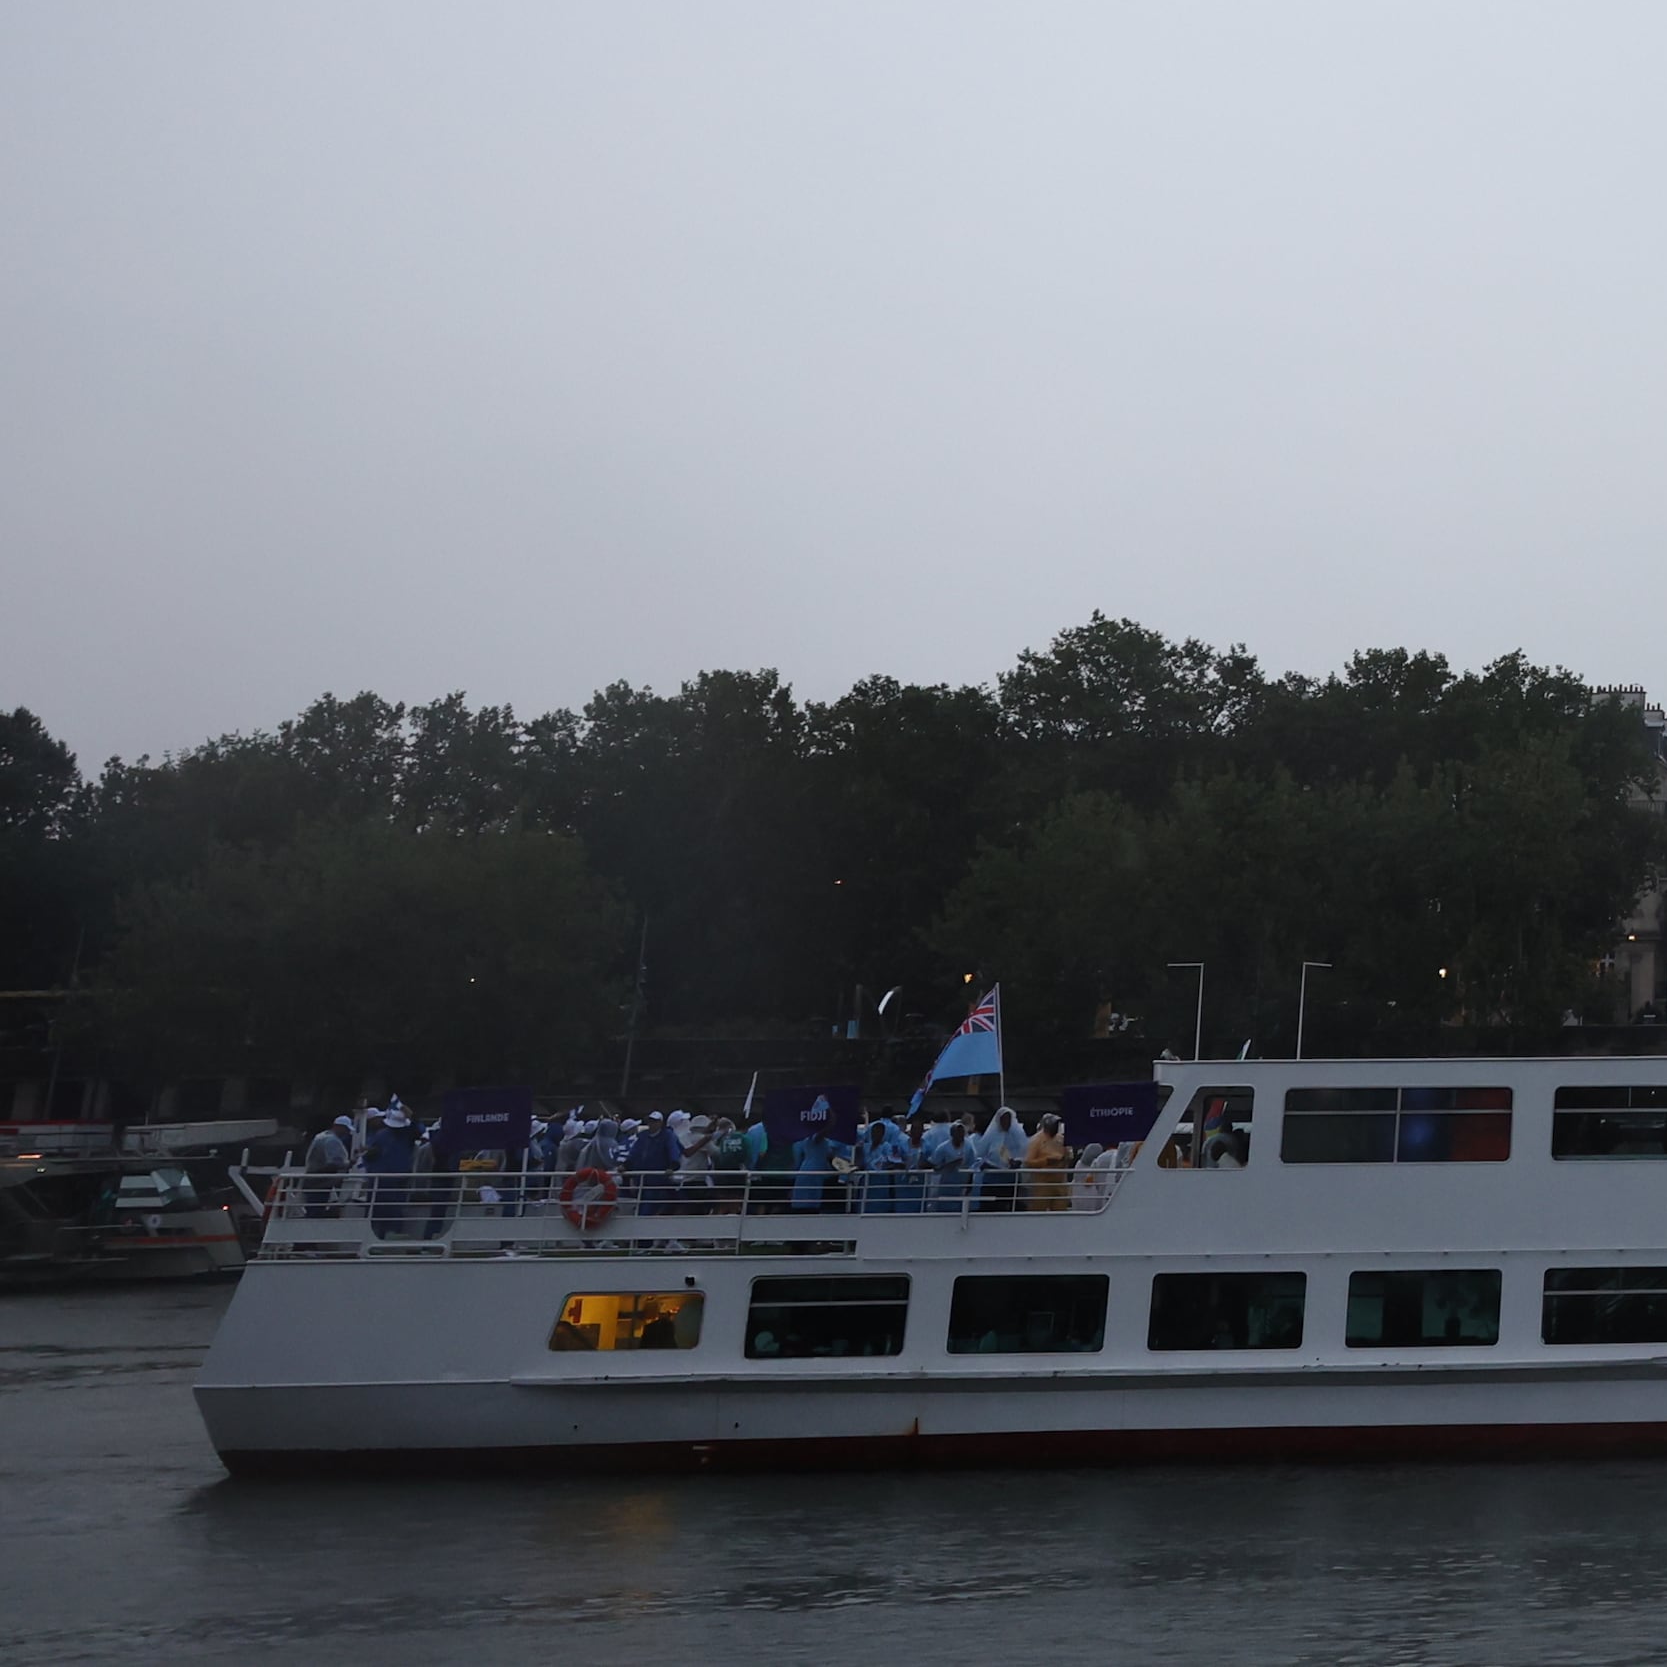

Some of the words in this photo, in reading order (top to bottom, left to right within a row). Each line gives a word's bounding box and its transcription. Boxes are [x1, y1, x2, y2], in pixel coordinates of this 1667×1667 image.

[800, 1110, 827, 1121] FIDJI
[1090, 1106, 1134, 1118] ÉTHIOPIE
[466, 1113, 510, 1124] FINLANDE
